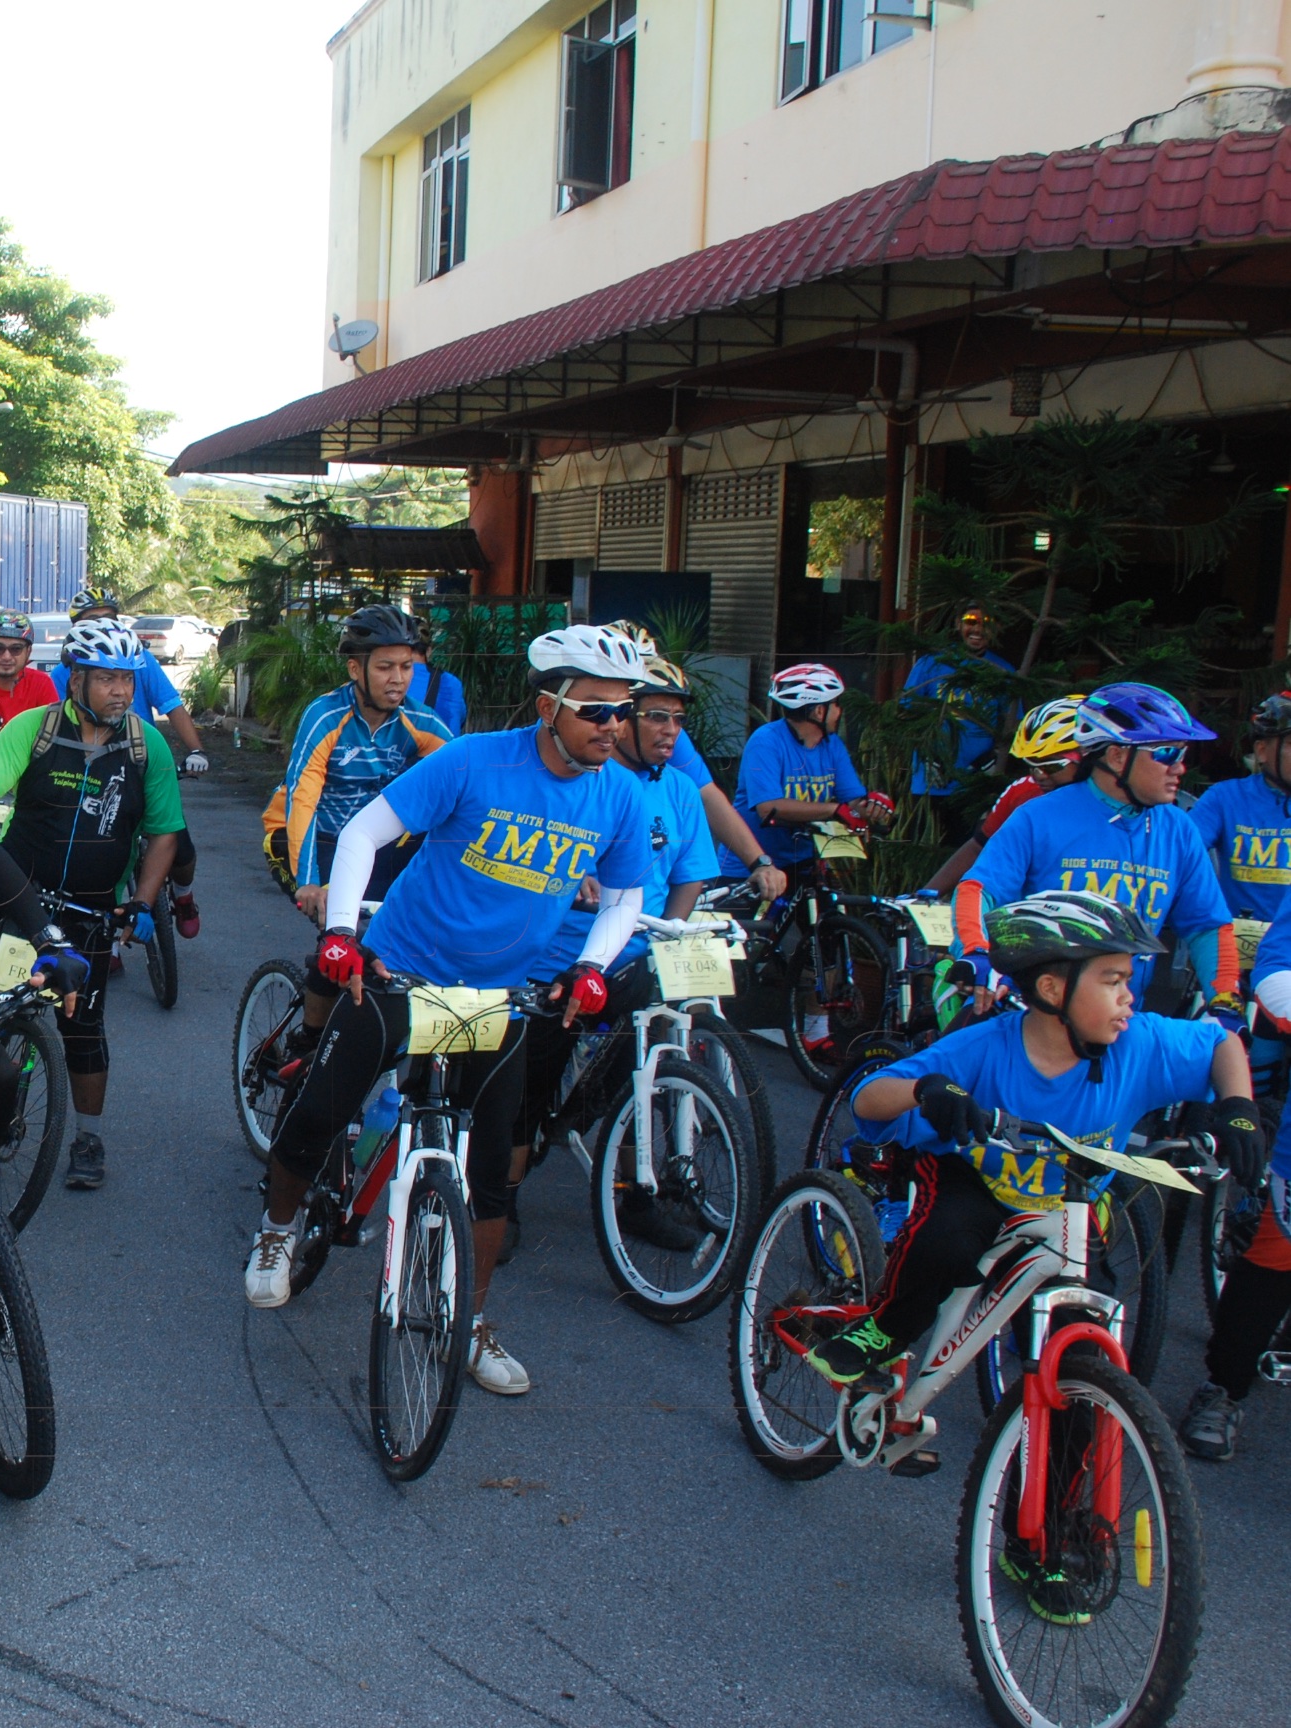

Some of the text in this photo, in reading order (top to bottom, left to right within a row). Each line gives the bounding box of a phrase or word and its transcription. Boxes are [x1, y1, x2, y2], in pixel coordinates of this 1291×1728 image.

[54, 779, 76, 788] Taiping
[487, 808, 601, 843] RIDE WITH COMMUNITY
[468, 820, 596, 880] 1MYC
[464, 851, 498, 876] UCTC
[1061, 858, 1087, 868] RIDE
[1091, 859, 1118, 870] WITH
[1060, 870, 1168, 919] 1MYC
[9, 965, 27, 980] FR
[674, 960, 718, 974] FR 048
[432, 1020, 490, 1035] FR 15
[936, 1290, 1001, 1363] OYAMA
